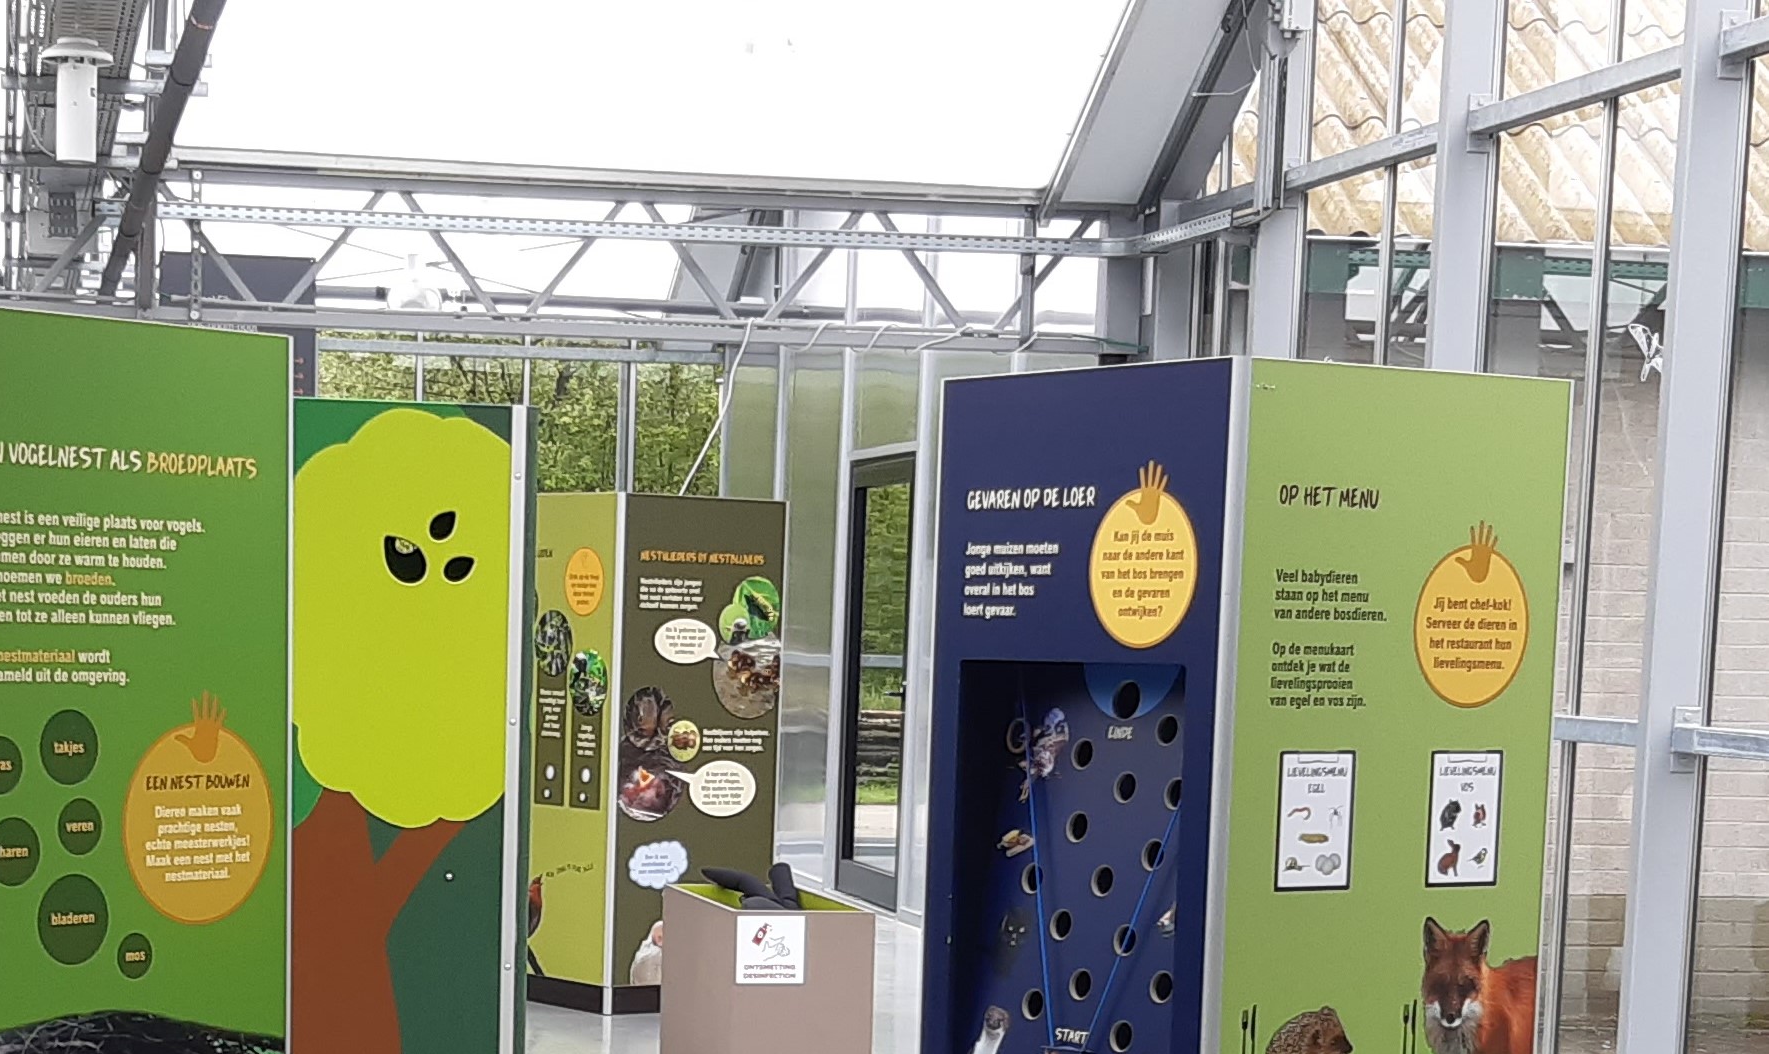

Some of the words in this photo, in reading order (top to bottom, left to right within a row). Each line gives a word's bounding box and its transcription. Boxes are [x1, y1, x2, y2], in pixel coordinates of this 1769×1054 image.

[8, 443, 106, 468] VOGELNEST
[109, 449, 142, 471] ALS
[146, 452, 256, 477] BROEDPLAATS
[967, 489, 1020, 509] GEVAREN
[1023, 488, 1040, 507] OP
[1043, 487, 1059, 507] DE
[1062, 486, 1095, 506] LOER
[1279, 484, 1299, 505] OP
[1303, 486, 1337, 506] HET
[1338, 488, 1379, 508] MENU
[24, 510, 34, 524] is
[37, 514, 59, 525] een
[61, 512, 100, 530] veilige
[103, 514, 137, 531] plaats
[139, 519, 164, 530] voor
[166, 518, 205, 535] vogels.
[33, 533, 45, 544] er
[48, 530, 70, 545] hun
[73, 532, 109, 547] eieren
[111, 537, 126, 547] en
[128, 534, 156, 549] laten
[159, 536, 176, 550] die
[28, 550, 56, 564] door
[58, 553, 71, 565] ze
[73, 554, 105, 566] warm
[107, 553, 119, 566] te
[122, 553, 166, 568] houden.
[44, 573, 62, 584] we
[65, 571, 115, 585] broeden.
[1275, 568, 1298, 582] Veel
[1301, 569, 1357, 586] babydieren
[1275, 587, 1303, 600] staan
[1305, 591, 1318, 604] op
[1321, 588, 1338, 601] het
[1340, 592, 1369, 602] menu
[1274, 608, 1292, 618] van
[1295, 606, 1330, 619] andere
[1333, 607, 1386, 621] bosdieren.
[77, 649, 110, 663] wordt
[35, 667, 51, 681] uit
[53, 667, 68, 681] de
[70, 668, 129, 685] omgeving.
[53, 741, 84, 756] takjes
[146, 775, 167, 790] EEN
[170, 774, 203, 789] NEST
[205, 773, 249, 789] BOUWEN
[65, 821, 93, 831] veren
[50, 912, 94, 925] bladeren
[125, 951, 145, 961] mos
[1055, 1028, 1089, 1043] START
